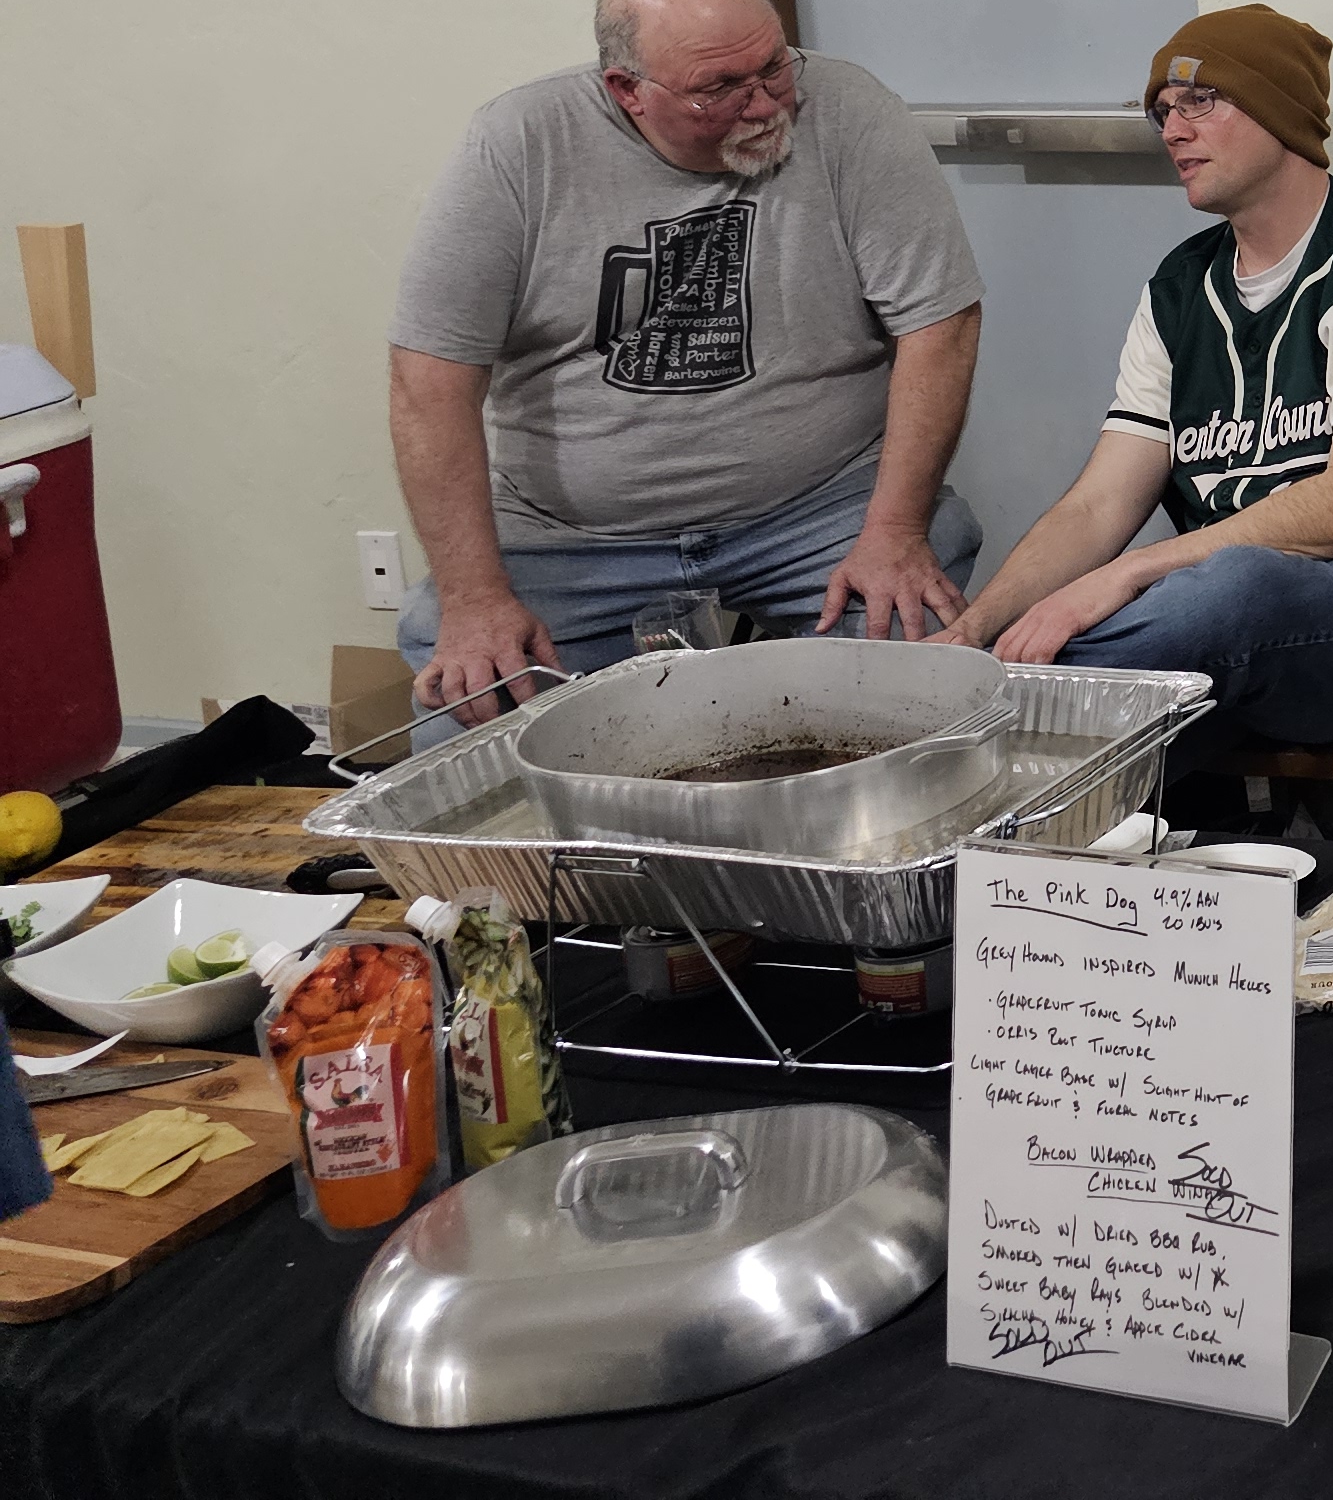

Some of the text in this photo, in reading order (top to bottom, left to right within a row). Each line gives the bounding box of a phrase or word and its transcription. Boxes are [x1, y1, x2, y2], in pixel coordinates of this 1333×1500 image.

[724, 210, 744, 265] Trippel
[672, 283, 699, 298] PA
[701, 247, 724, 312] Amber
[642, 332, 667, 381] Marzen
[685, 347, 740, 364] Porter
[1175, 409, 1256, 464] enton
[987, 879, 1220, 927] The Pink Dog 4.9% ABV
[1162, 915, 1183, 930] 20
[1083, 956, 1156, 977] INSPIRED
[1174, 960, 1219, 986] MUNICH
[997, 990, 1177, 1036] GRAPEFRUIT TONIC SYRUP
[997, 1026, 1038, 1040] ORRIS
[1088, 1037, 1156, 1062] TINCTURE
[970, 1053, 1007, 1073] LIGHT
[1143, 1075, 1191, 1097] SLIGHT
[1194, 1087, 1232, 1106] HINT
[1233, 1094, 1250, 1107] OF
[1149, 1106, 1199, 1127] NOTES
[1027, 1135, 1077, 1161] BACON
[1091, 1145, 1157, 1170] WRAPPED
[1087, 1172, 1156, 1193] CHICKEN
[984, 1199, 1041, 1234] DUSTED
[1094, 1220, 1139, 1246] DRIED
[1150, 1229, 1180, 1251] BBQ
[982, 1239, 1042, 1267] SMOKED
[1053, 1255, 1091, 1270] THEN
[978, 1270, 1028, 1292] SWEET
[1039, 1276, 1077, 1314] BABY
[1143, 1289, 1212, 1316] BLENDED
[1124, 1315, 1166, 1339] APPLE
[1173, 1319, 1221, 1345] CIDER
[1187, 1349, 1247, 1368] VINEGAR
